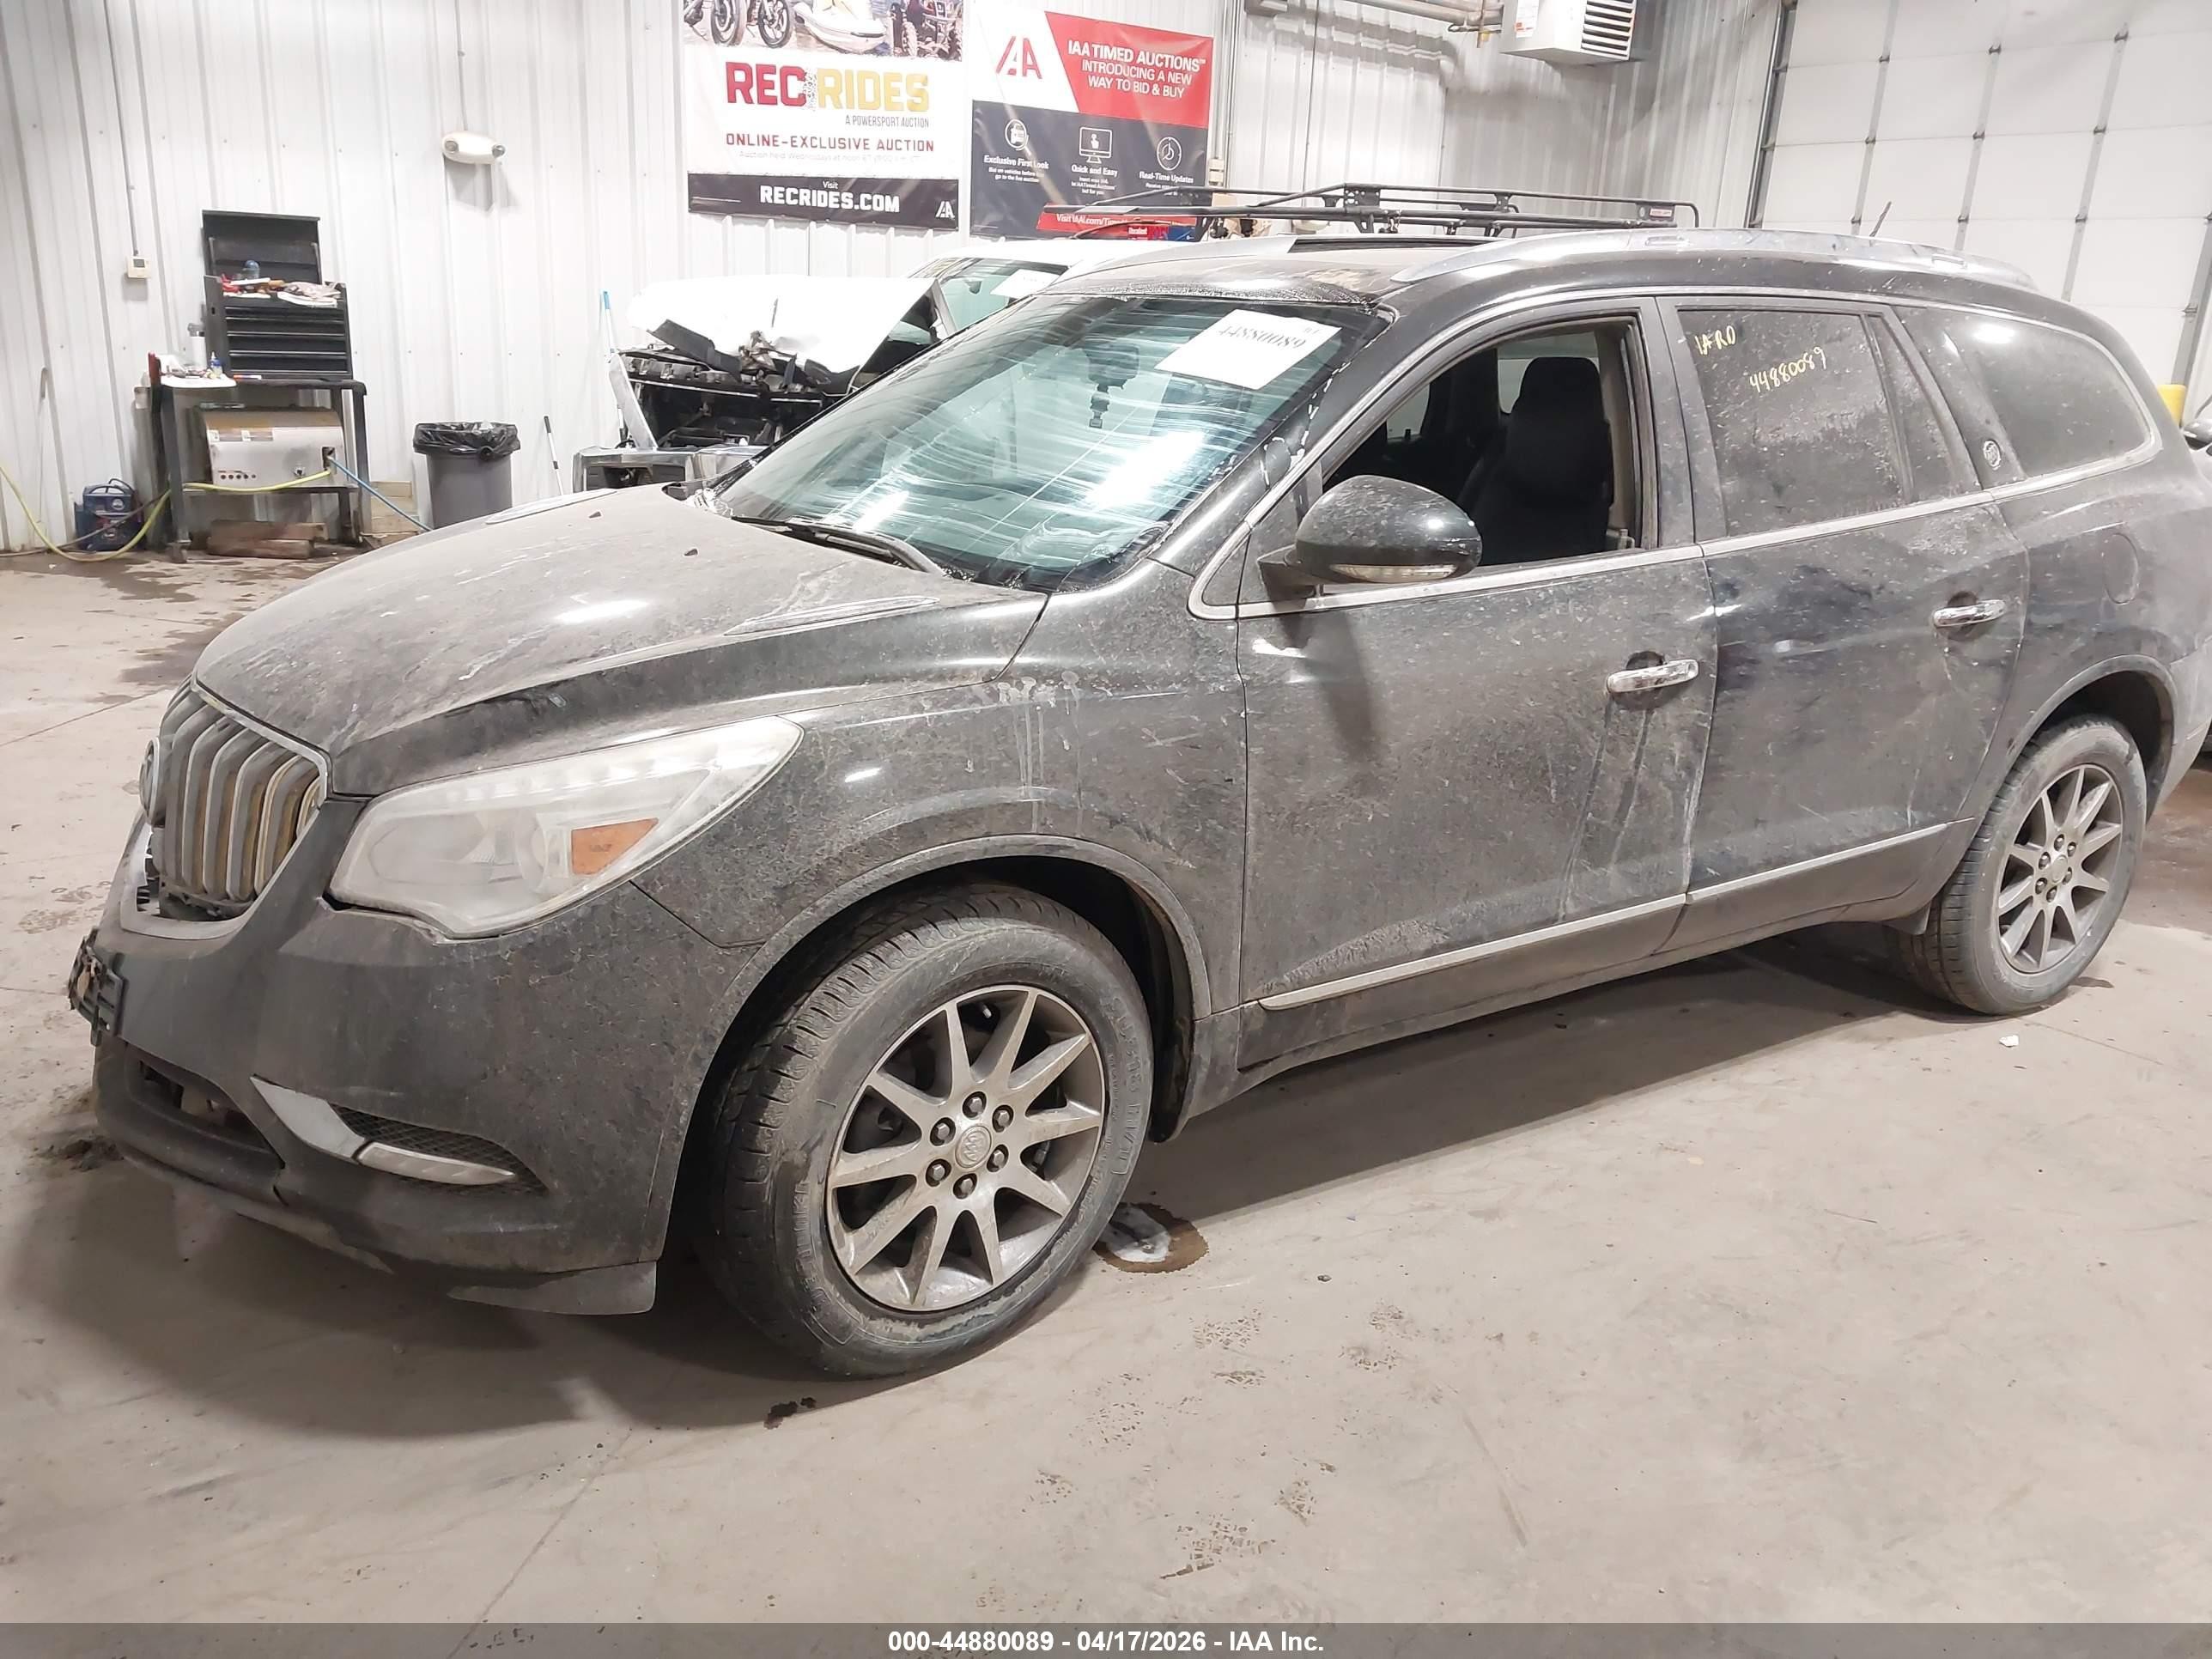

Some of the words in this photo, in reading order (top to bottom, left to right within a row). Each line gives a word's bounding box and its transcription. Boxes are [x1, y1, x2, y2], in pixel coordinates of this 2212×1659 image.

[1067, 40, 1090, 56] IAA
[1091, 43, 1133, 63] TIMED
[1082, 58, 1155, 81] INTRODUCING
[1158, 70, 1165, 82] A
[1168, 72, 1193, 86] NEW
[1088, 75, 1114, 89] WAY
[1115, 78, 1131, 92] TO
[1133, 81, 1150, 94] BID
[1152, 83, 1160, 96] &
[1163, 85, 1185, 99] BUY
[845, 114, 851, 125] A
[852, 115, 900, 128] POWERSPORT
[902, 117, 930, 129] AUCTION
[726, 132, 871, 151] ONLINE-EXCLUSIVE
[876, 138, 935, 152] AUCTION
[983, 155, 1016, 166] Exclusive
[1033, 161, 1049, 170] Look
[1071, 164, 1089, 174] Quick
[1103, 167, 1118, 178] Easy
[823, 180, 839, 190] Visit
[1139, 171, 1170, 181] Real-Time
[1170, 174, 1194, 184] Updates
[760, 185, 900, 213] RECRIDES.COM
[1056, 213, 1073, 222] Visit
[1749, 346, 1827, 393] 44880089
